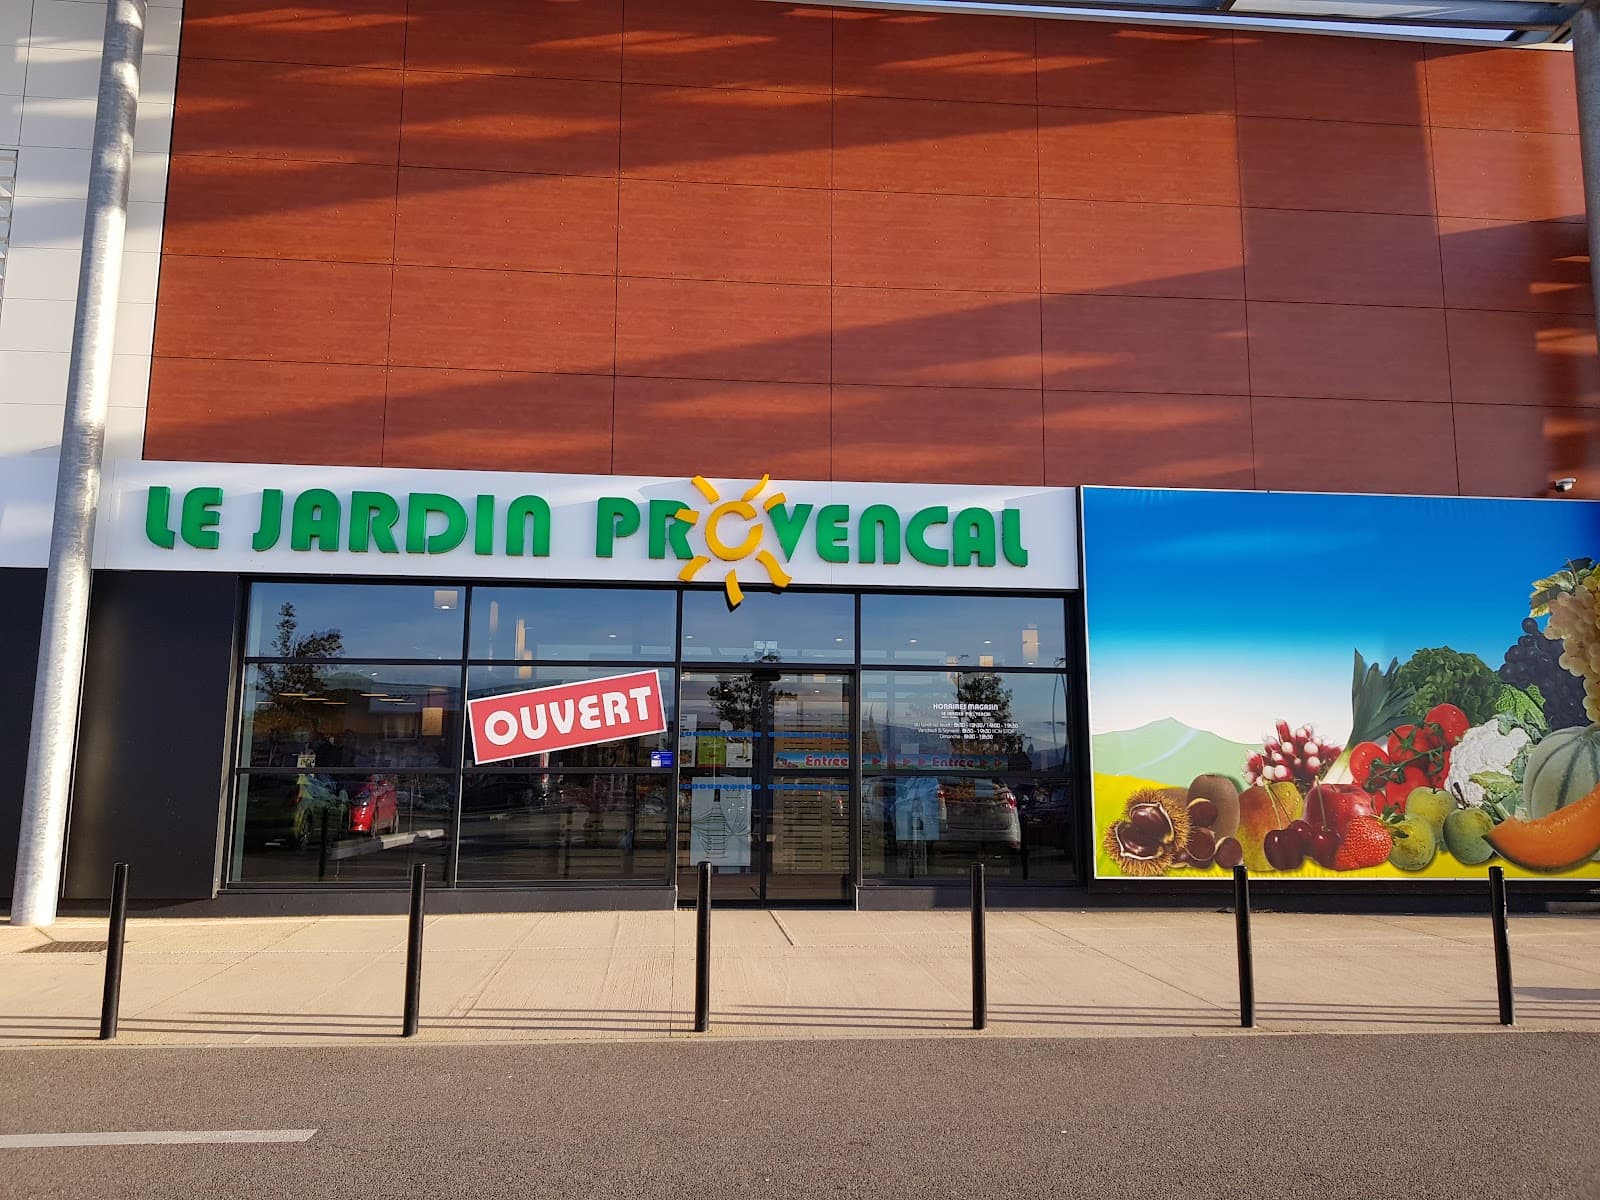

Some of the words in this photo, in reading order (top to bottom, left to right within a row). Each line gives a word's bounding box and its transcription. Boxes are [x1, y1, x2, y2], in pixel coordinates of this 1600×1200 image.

[146, 486, 223, 549] LE
[252, 488, 551, 558] JARDIN
[595, 493, 1029, 571] PROVENCAL
[484, 686, 652, 746] OUVERT
